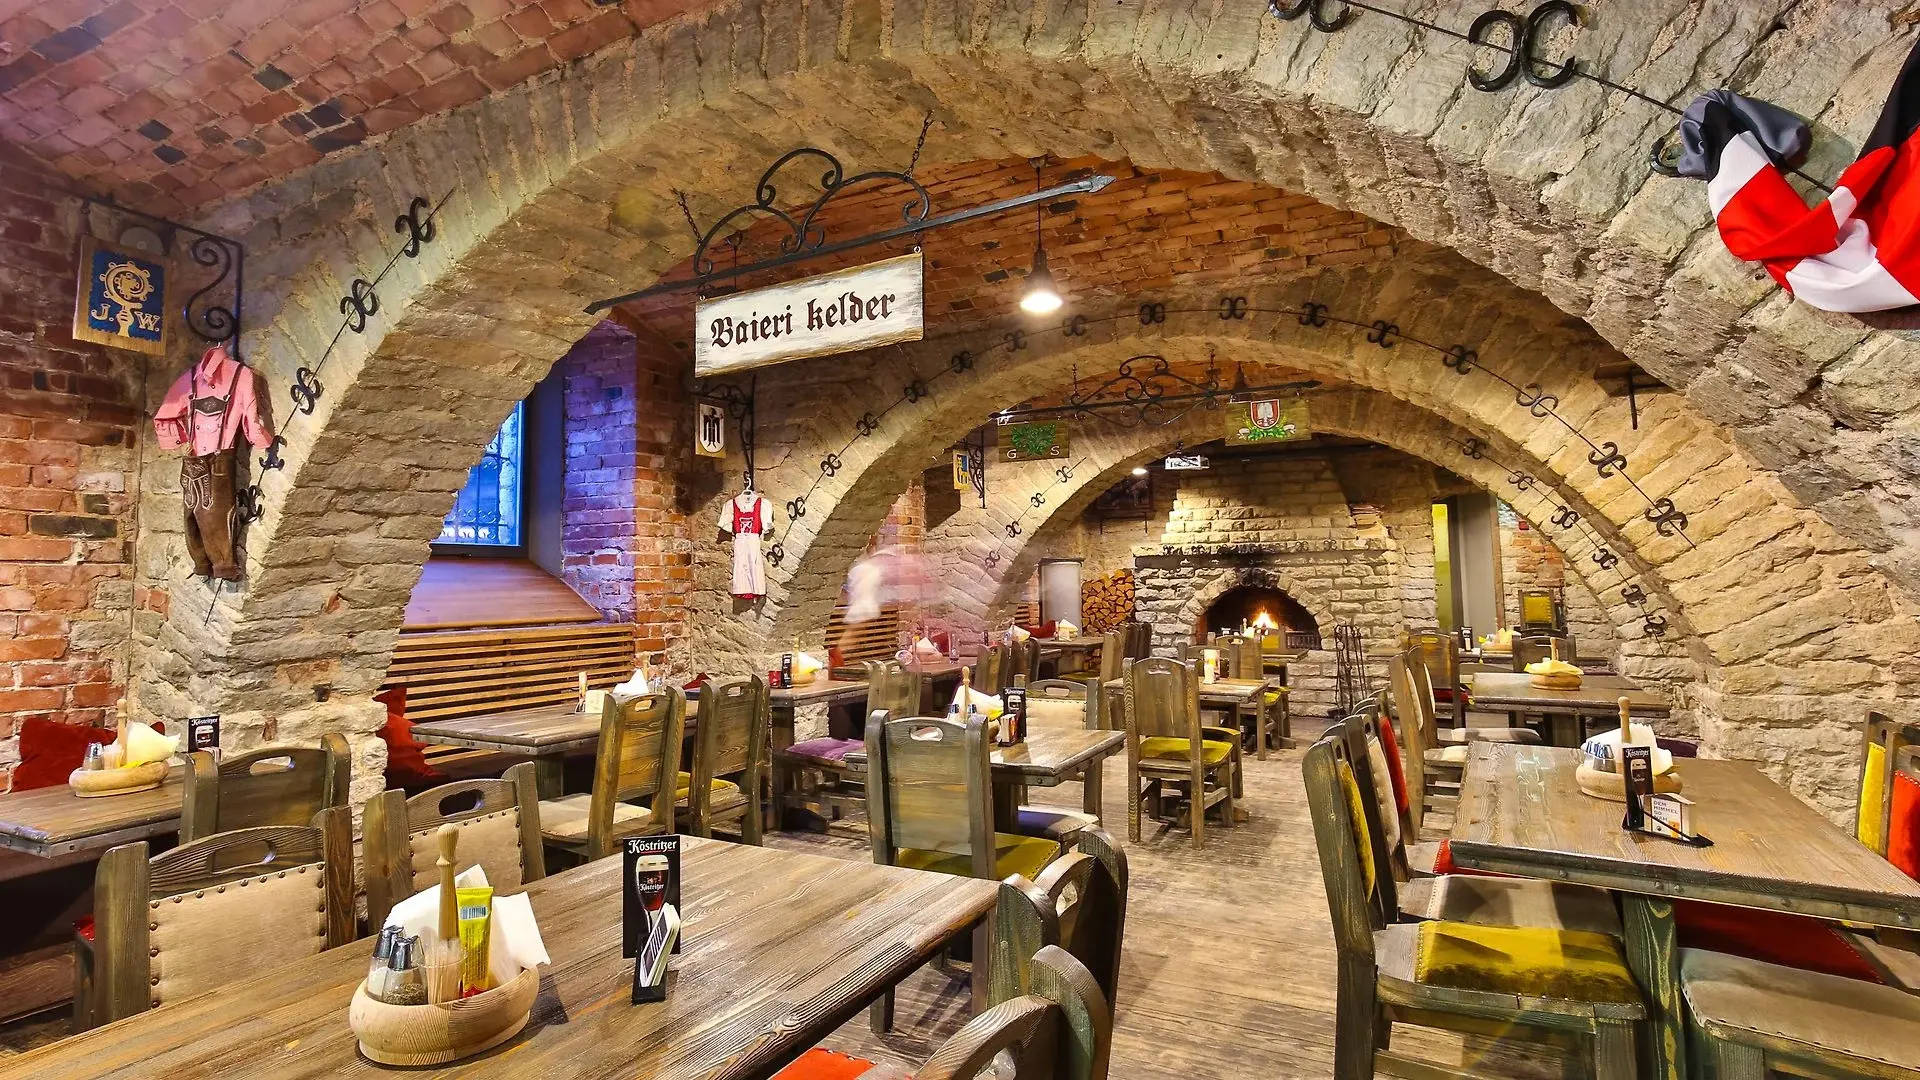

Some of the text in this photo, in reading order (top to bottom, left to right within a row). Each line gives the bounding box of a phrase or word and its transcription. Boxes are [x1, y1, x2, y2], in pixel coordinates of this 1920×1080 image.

[711, 291, 896, 348] Baieri kelder
[1006, 445, 1060, 459] G S
[628, 840, 677, 854] Köstritzer
